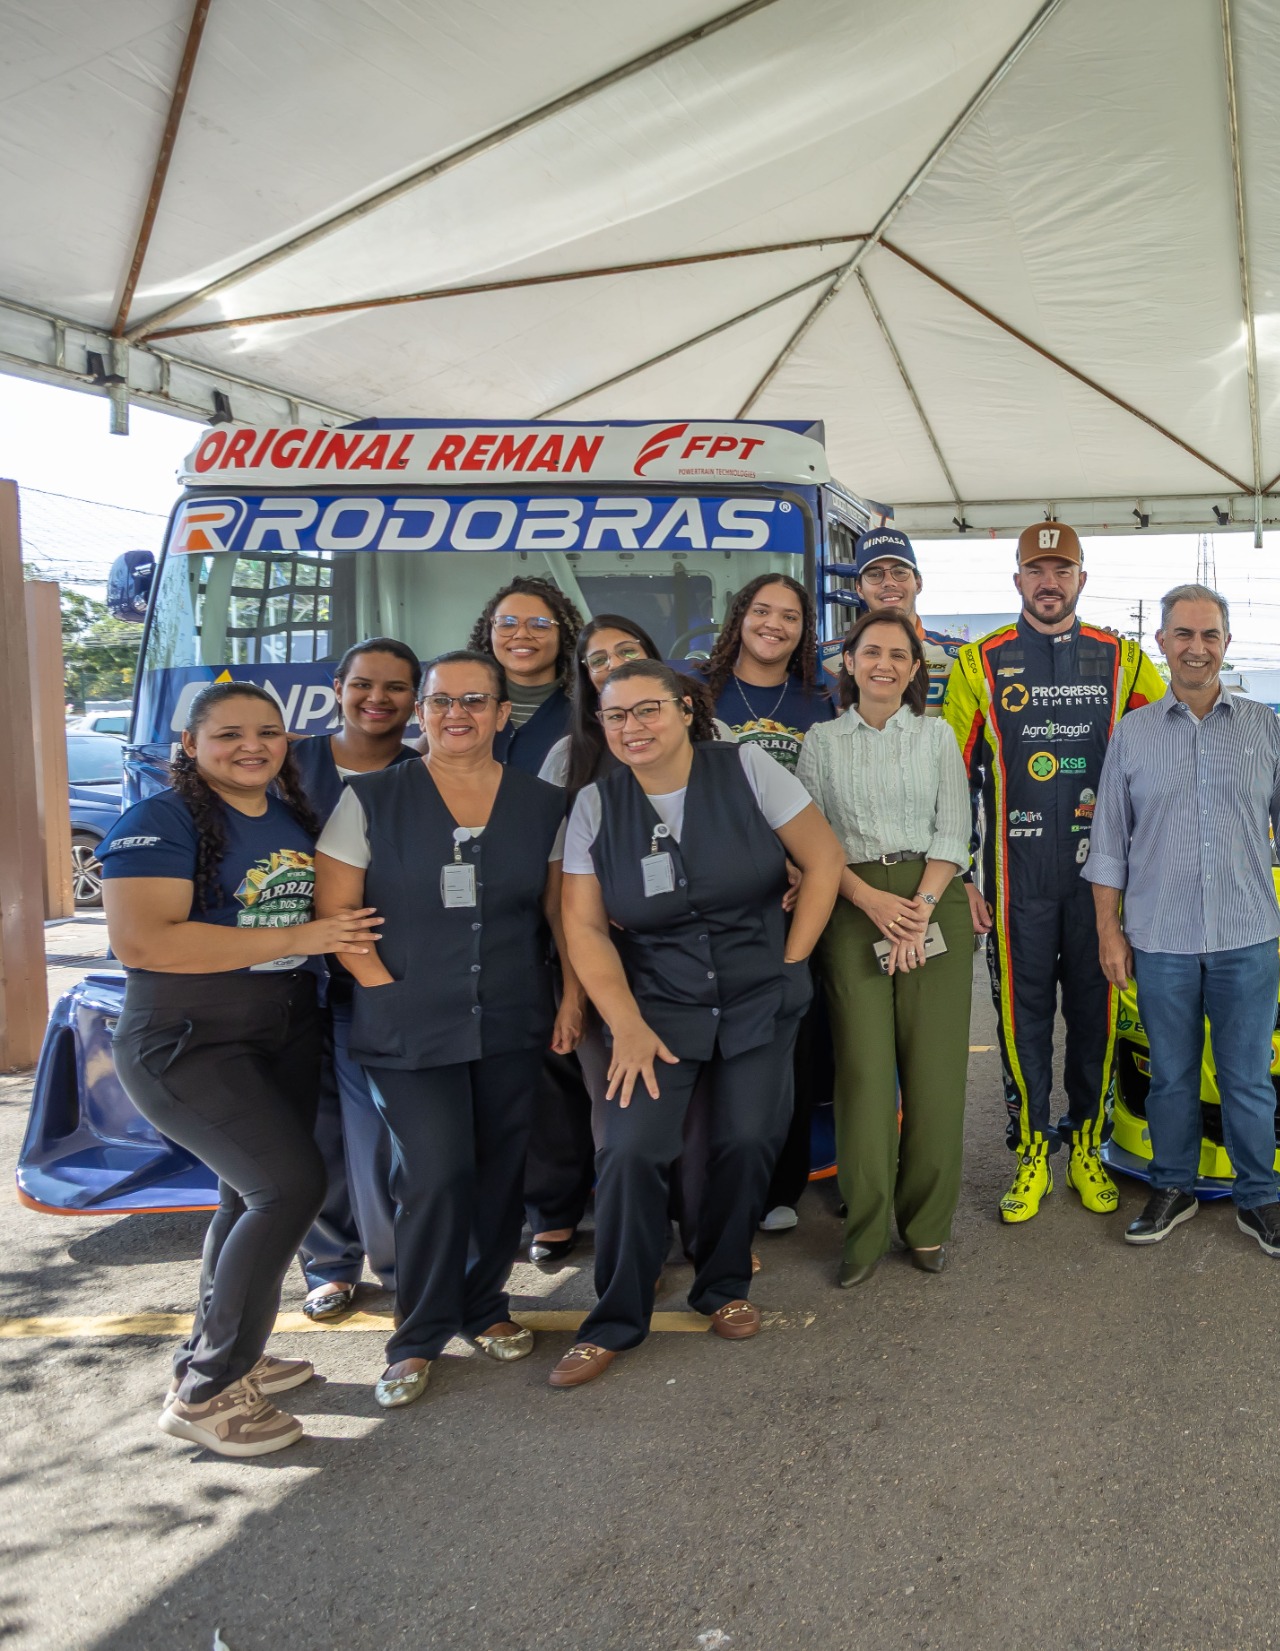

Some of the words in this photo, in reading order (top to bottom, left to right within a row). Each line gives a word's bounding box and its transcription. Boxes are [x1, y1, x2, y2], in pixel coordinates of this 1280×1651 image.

[194, 428, 415, 473] ORIGINAL
[427, 434, 604, 473] REMAN
[680, 436, 766, 460] FPT
[1038, 529, 1061, 549] 87
[1031, 685, 1107, 698] PROGRESSO
[1032, 696, 1109, 707] SEMENTES
[1060, 757, 1087, 769] KSB
[1009, 828, 1043, 837] GT1
[259, 881, 315, 904] ARRAI
[279, 900, 297, 909] DOS
